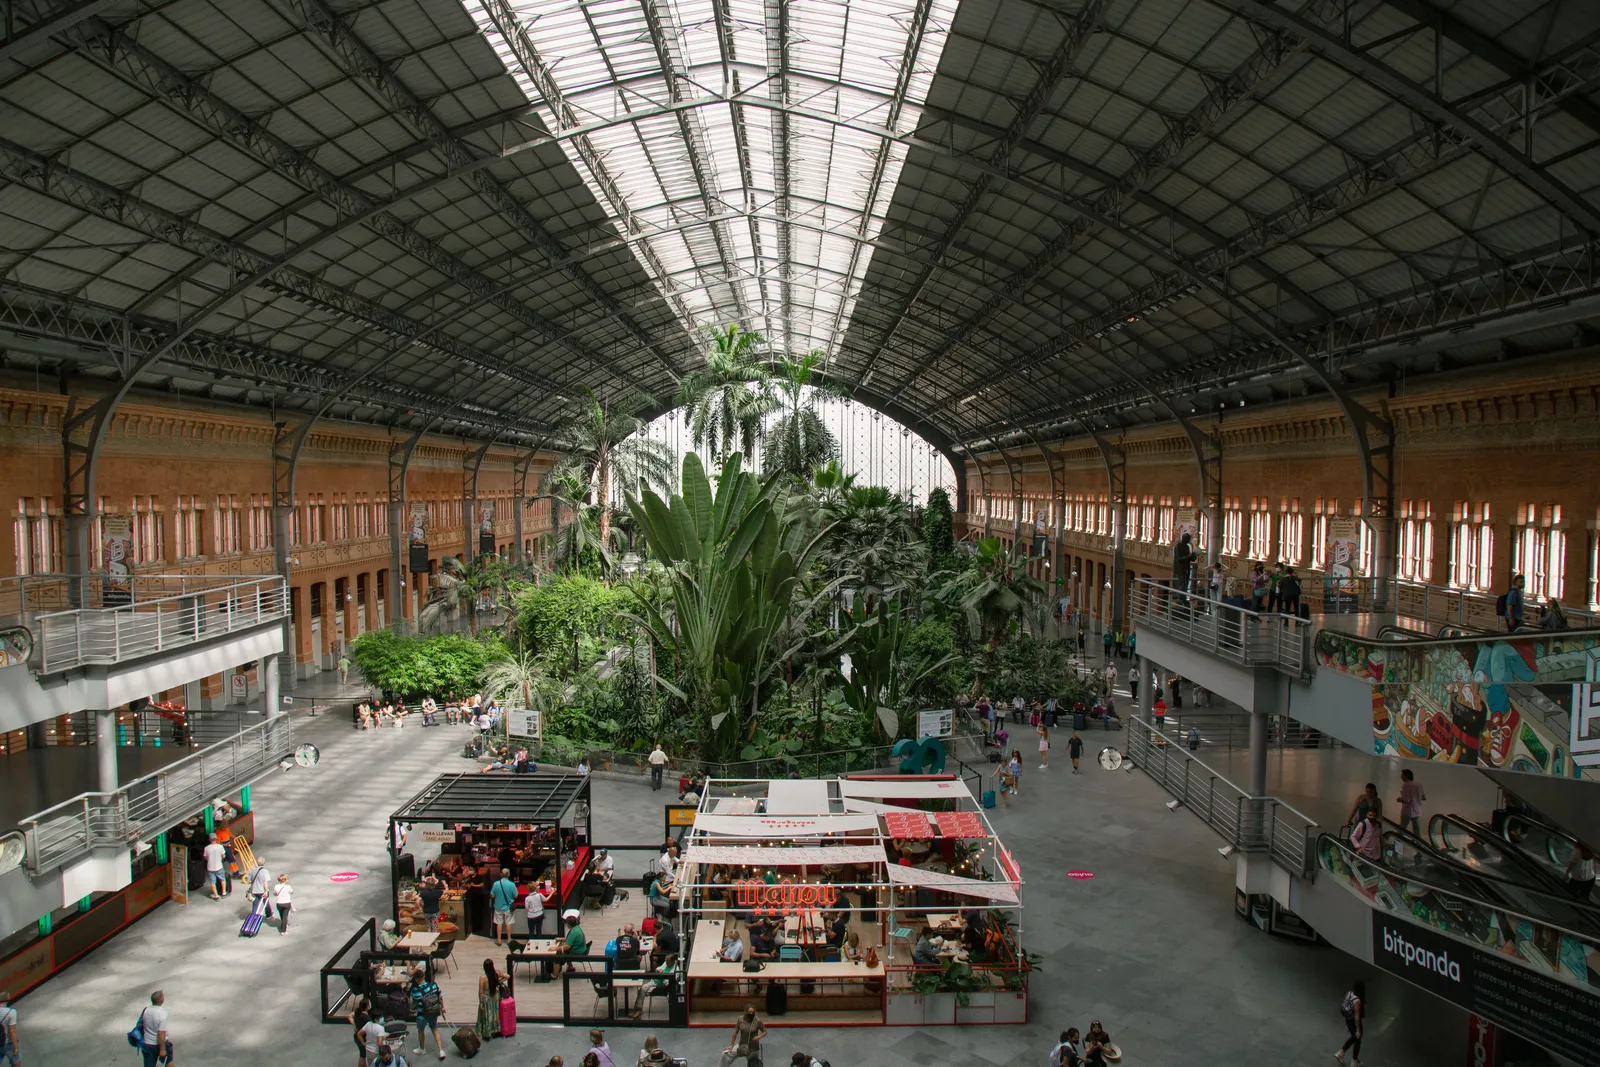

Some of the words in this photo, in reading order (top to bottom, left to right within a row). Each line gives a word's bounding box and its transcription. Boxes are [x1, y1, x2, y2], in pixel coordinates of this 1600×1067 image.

[736, 878, 837, 905] Mahou
[1382, 925, 1462, 983] bitpanda
[1472, 951, 1481, 961] La
[1512, 968, 1522, 977] en
[1522, 971, 1574, 999] criptoactivos
[1575, 993, 1588, 1003] no
[1505, 997, 1519, 1009] que
[1519, 1004, 1529, 1013] se
[1530, 1007, 1563, 1028] explican
[1517, 985, 1552, 1006] totalidad
[1553, 1001, 1567, 1013] del
[1568, 1005, 1600, 1028] importe
